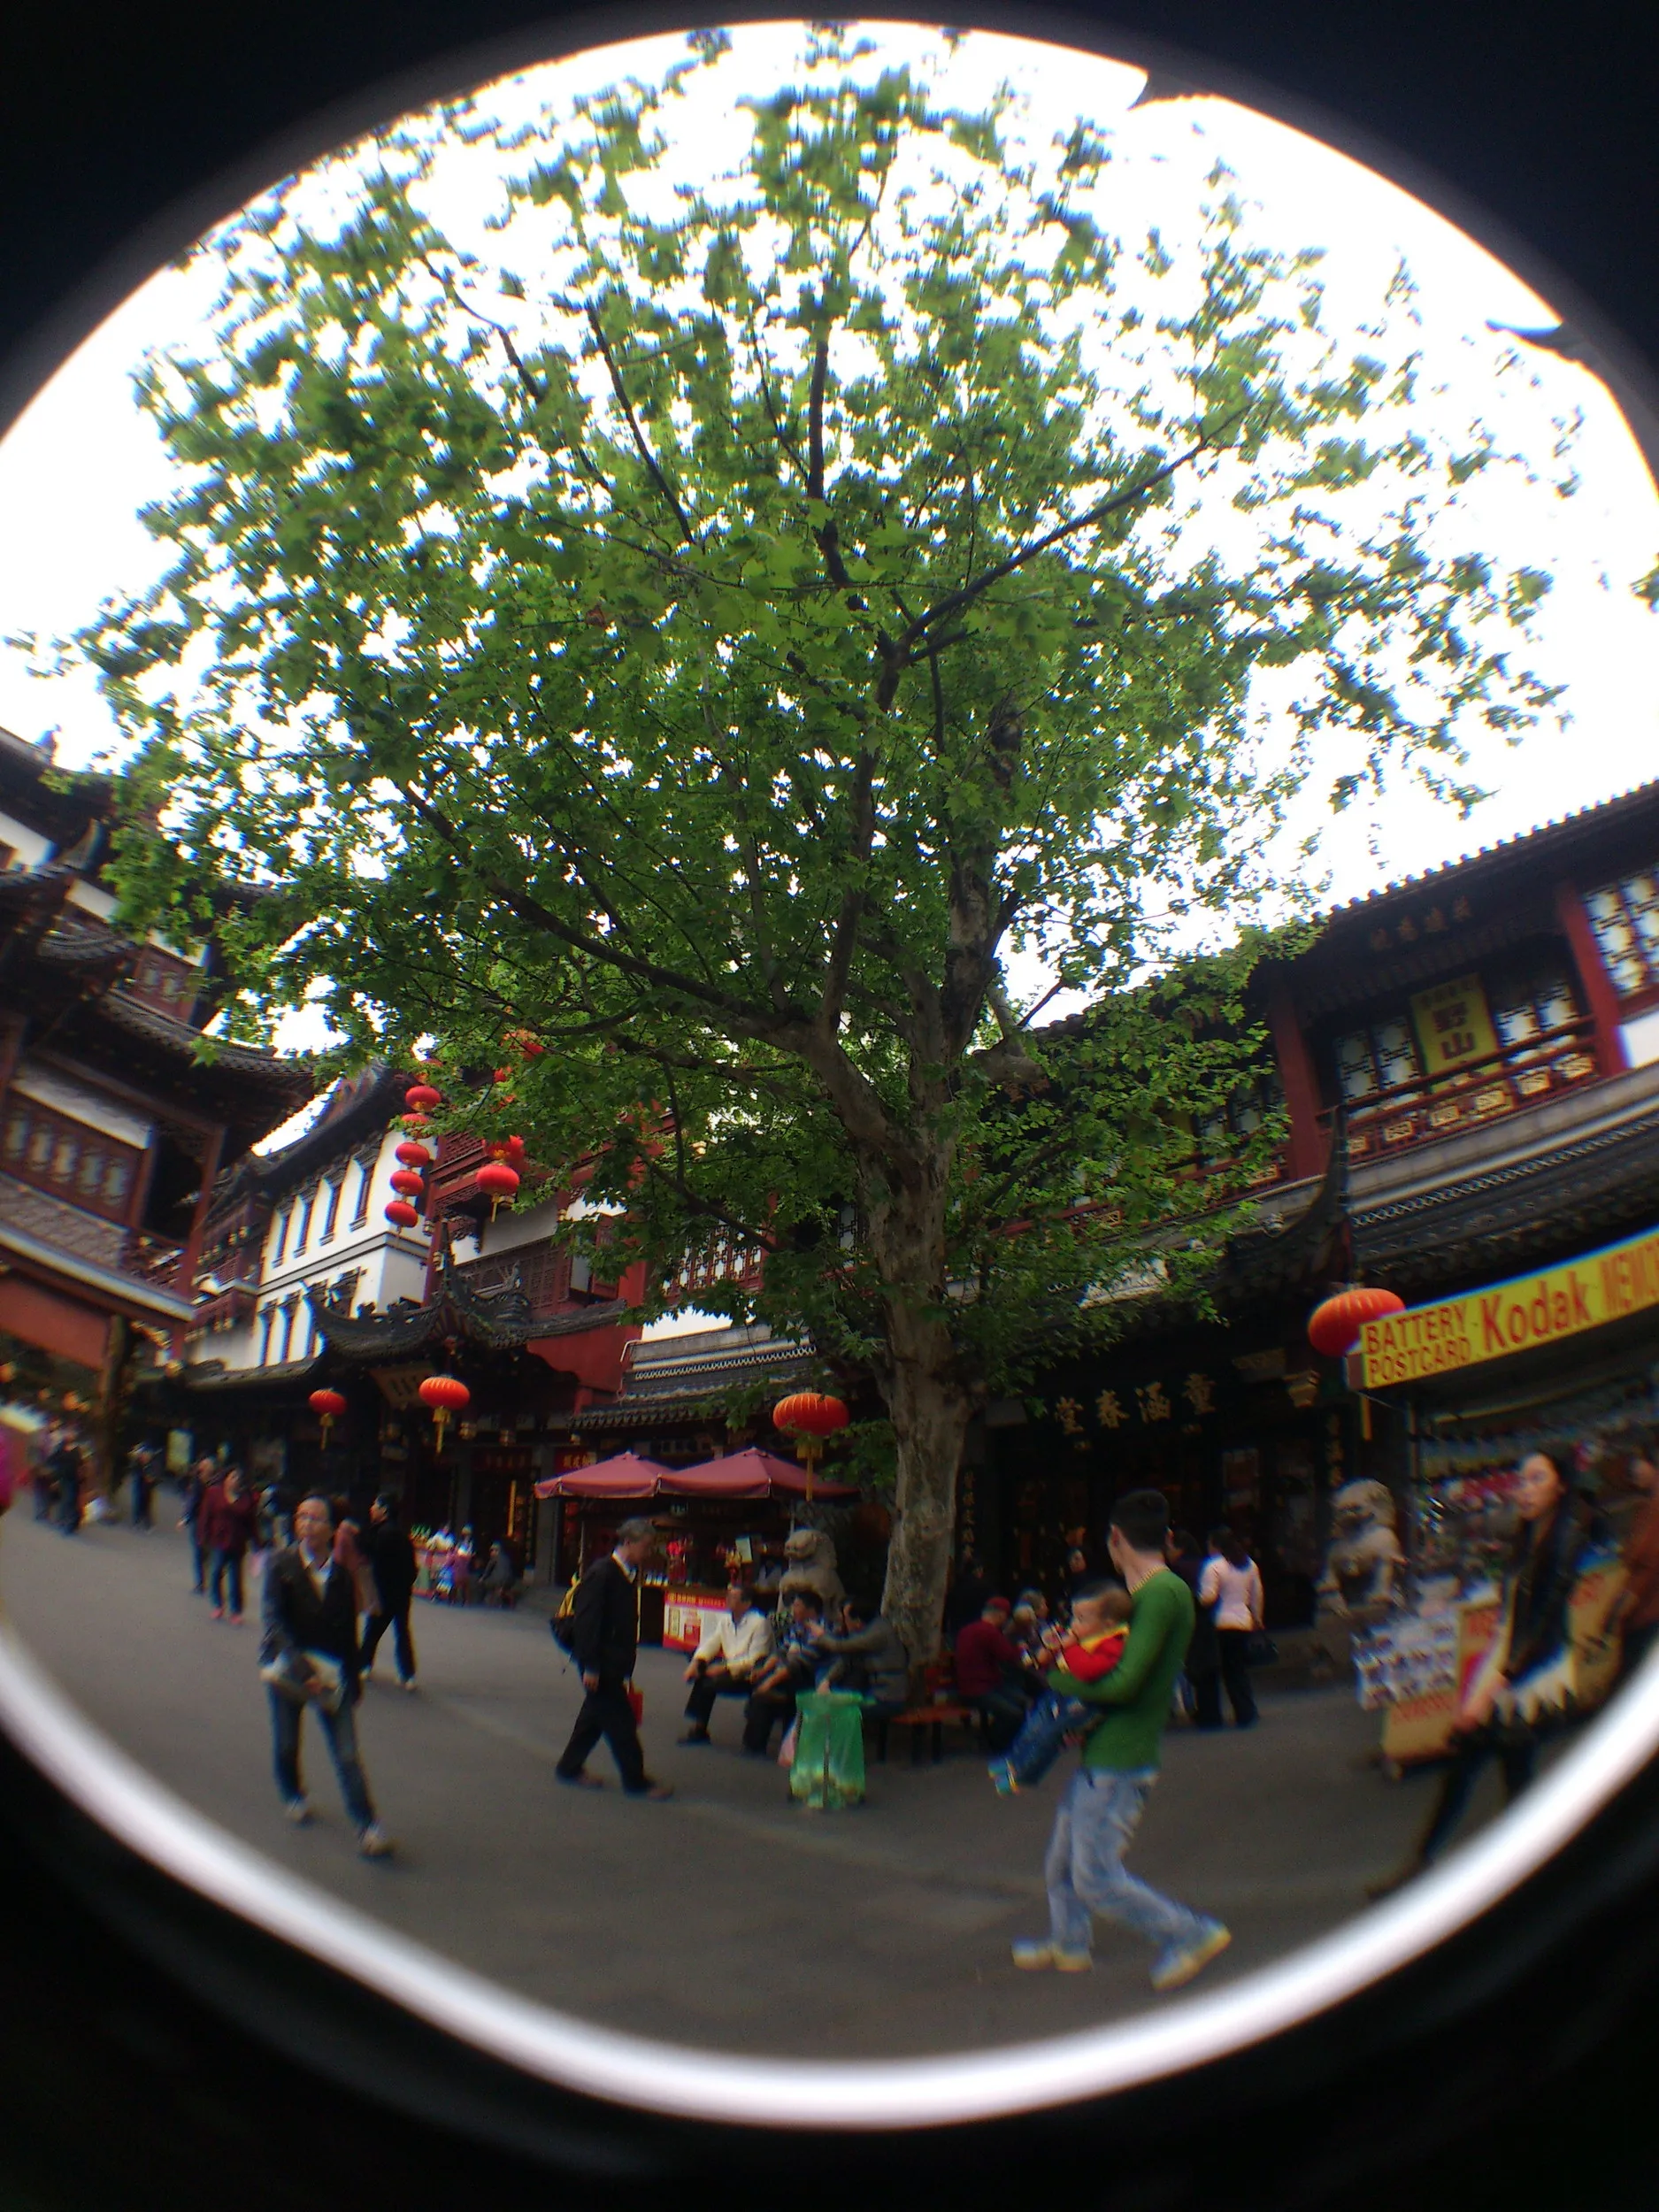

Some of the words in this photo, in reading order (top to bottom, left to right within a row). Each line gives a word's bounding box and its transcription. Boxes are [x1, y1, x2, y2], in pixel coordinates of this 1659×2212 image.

[1365, 1302, 1468, 1354] BATTERY
[1480, 1271, 1591, 1351] Kodak
[1368, 1337, 1471, 1384] POSTCARD
